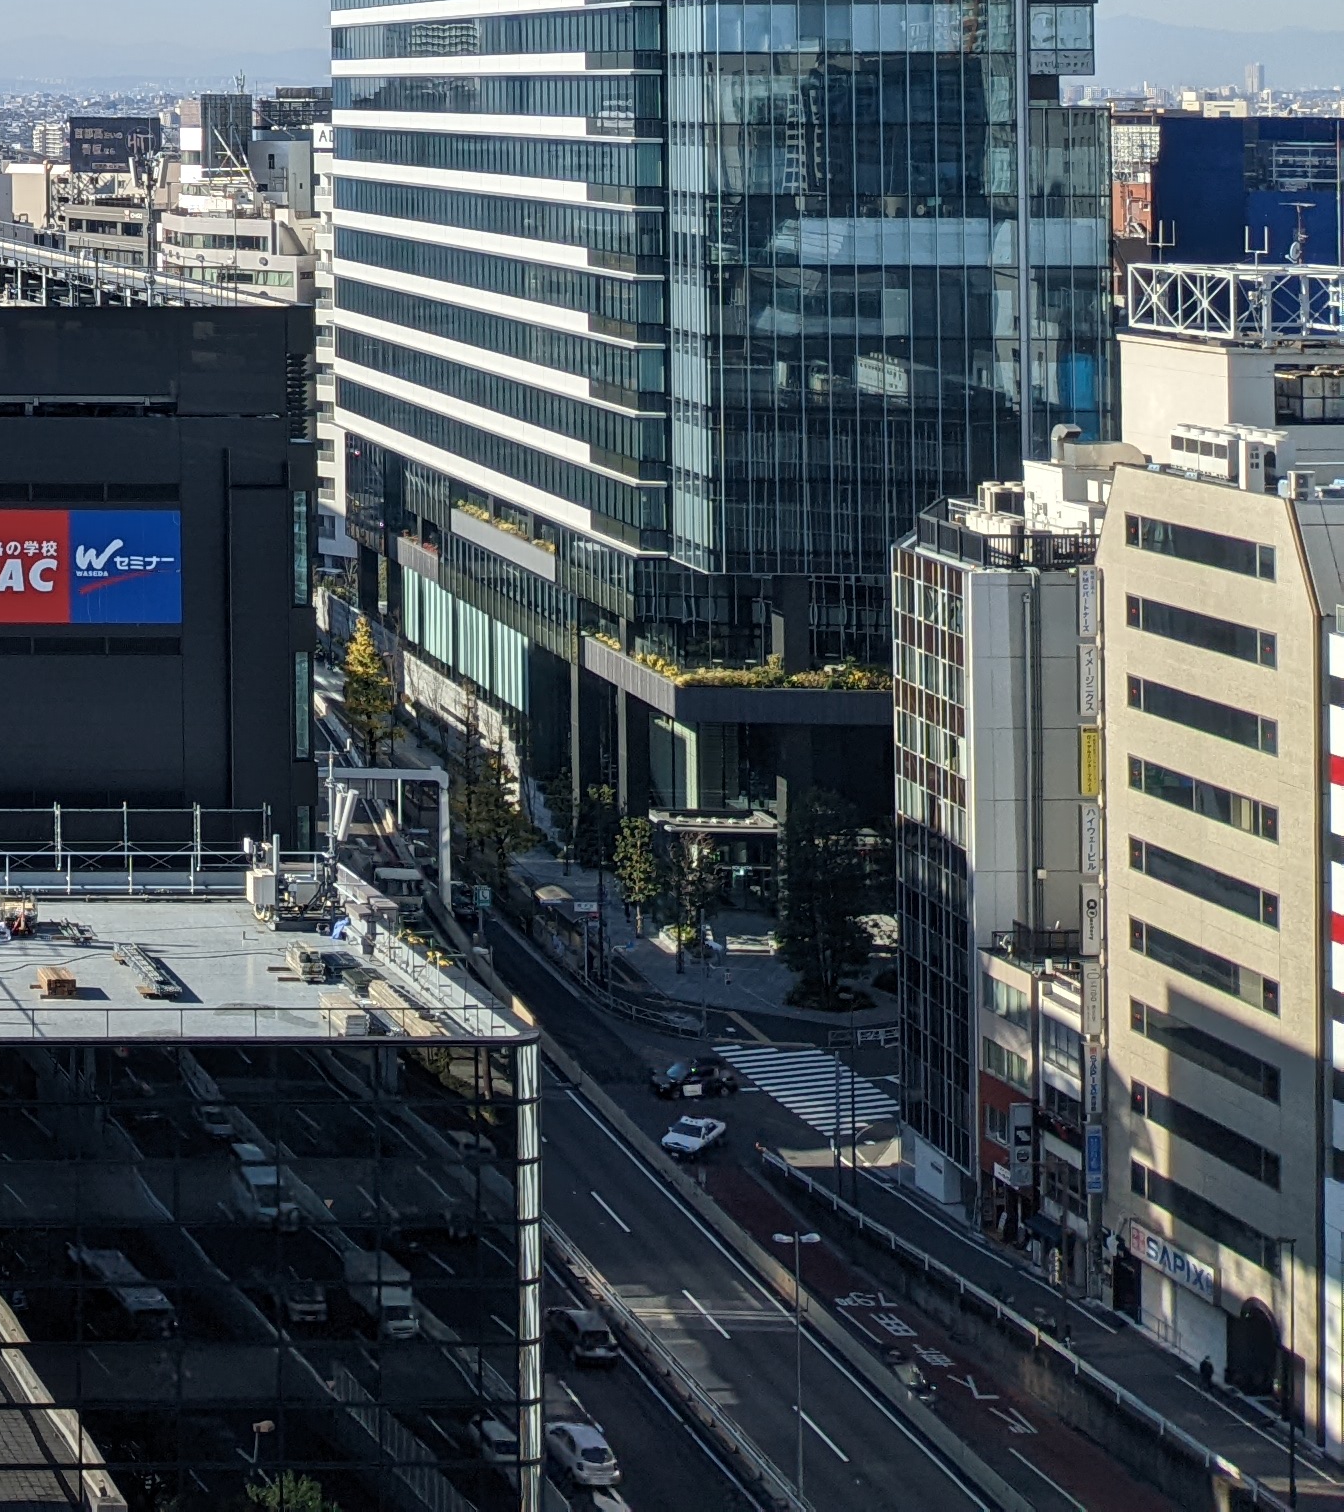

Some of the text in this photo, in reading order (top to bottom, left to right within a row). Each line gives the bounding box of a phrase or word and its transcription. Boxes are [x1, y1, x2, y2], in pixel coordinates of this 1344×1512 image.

[113, 555, 175, 570] セミナー
[1082, 570, 1090, 632] KMCパートナーズ
[1084, 648, 1095, 712] イメージニクス
[1086, 808, 1097, 871] ハイウェービル
[1146, 1236, 1205, 1291] SAPIX
